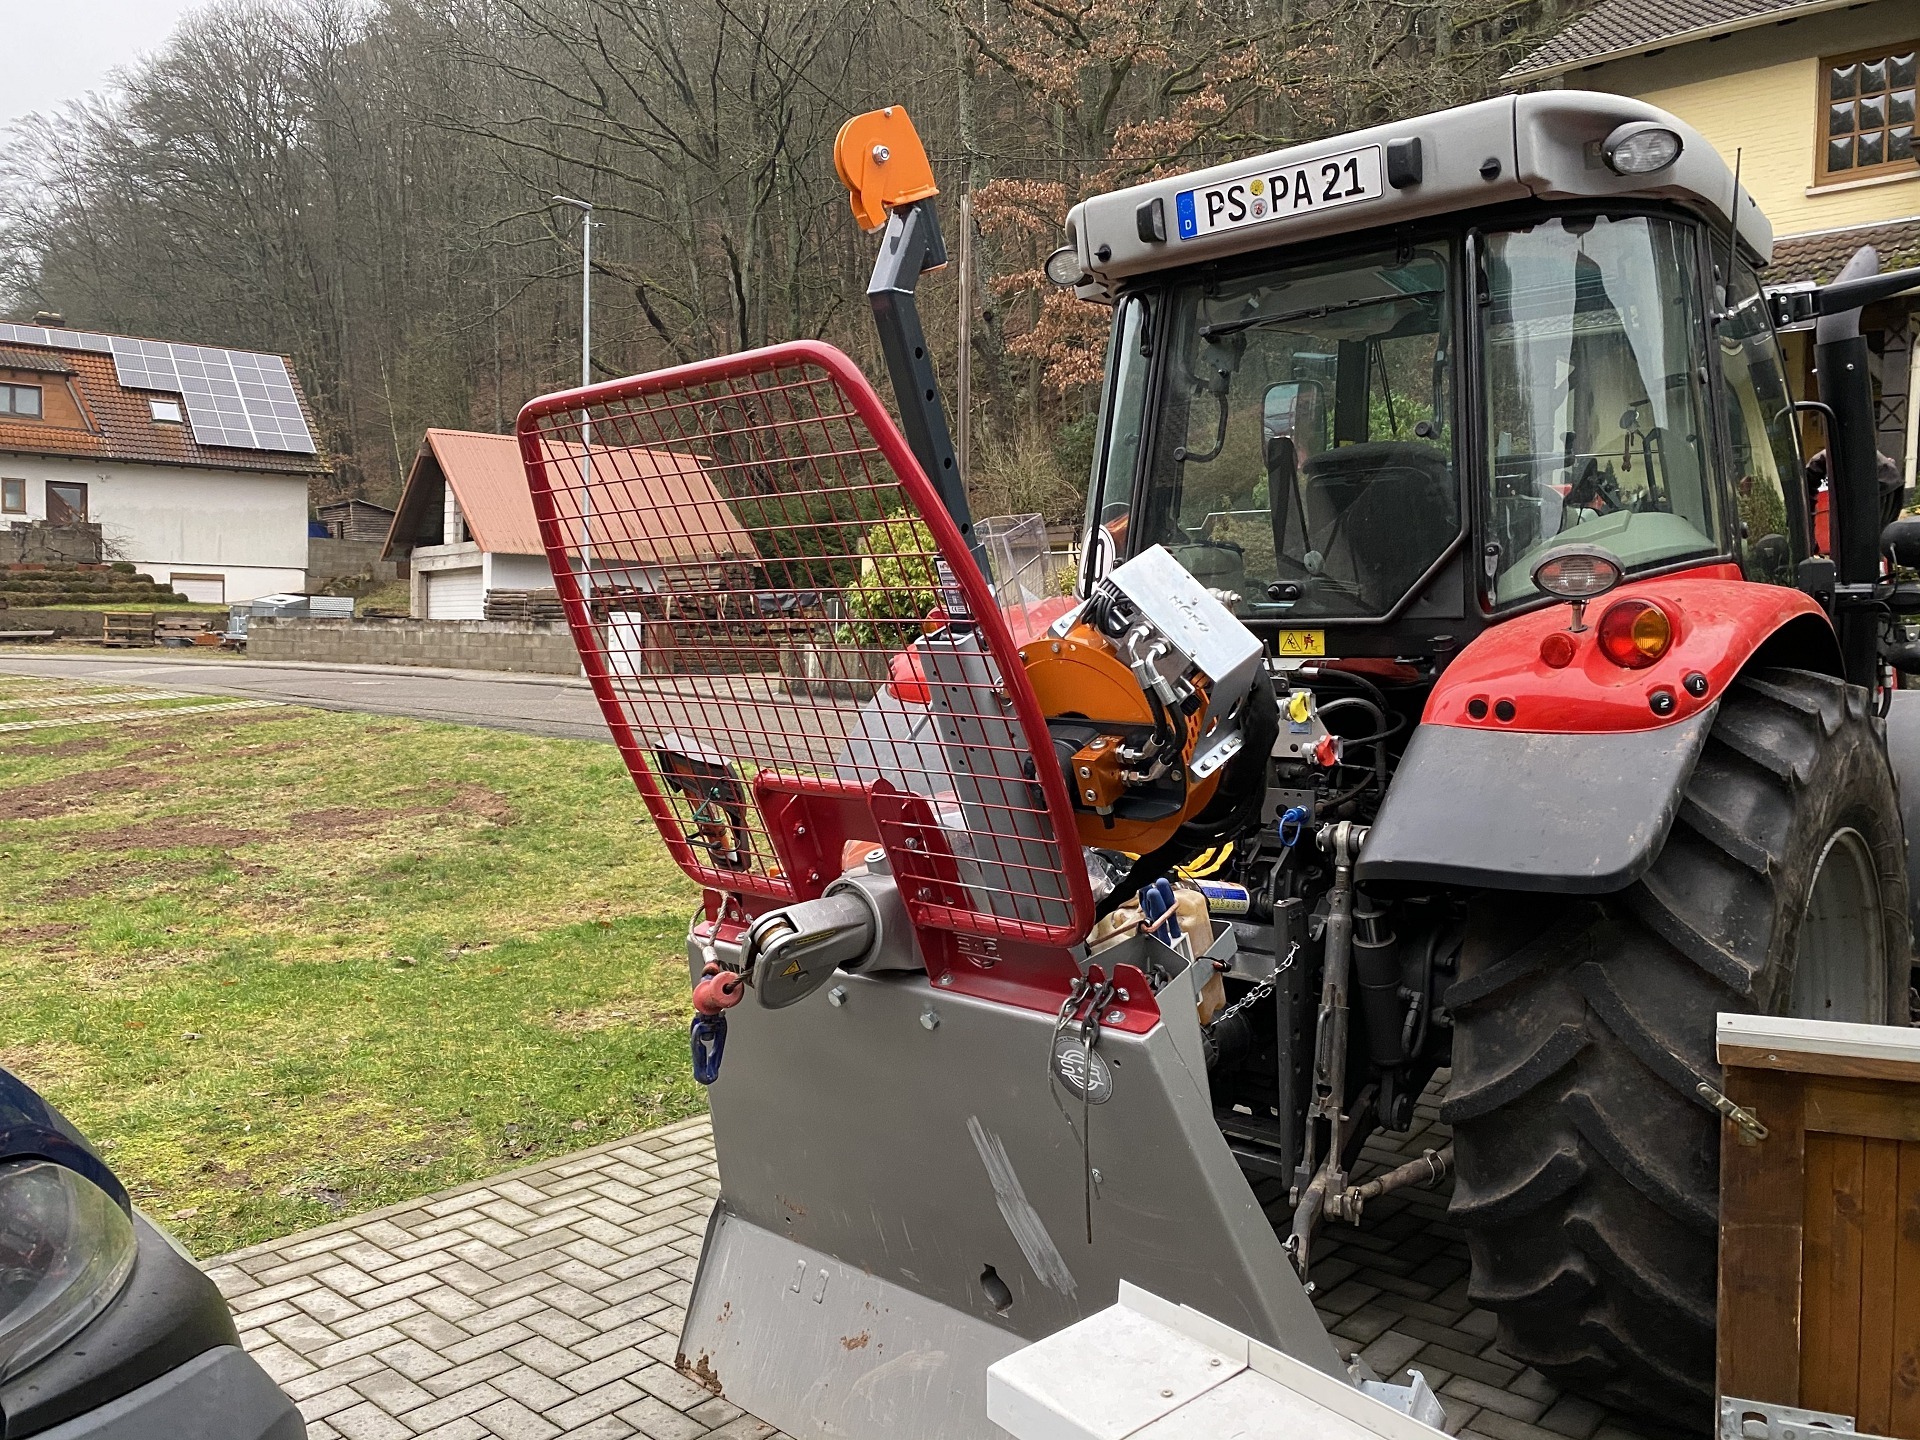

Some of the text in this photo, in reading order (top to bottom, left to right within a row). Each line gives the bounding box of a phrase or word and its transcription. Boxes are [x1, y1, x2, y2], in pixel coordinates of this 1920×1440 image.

[1205, 157, 1365, 227] PS PA 21
[1185, 219, 1192, 231] D
